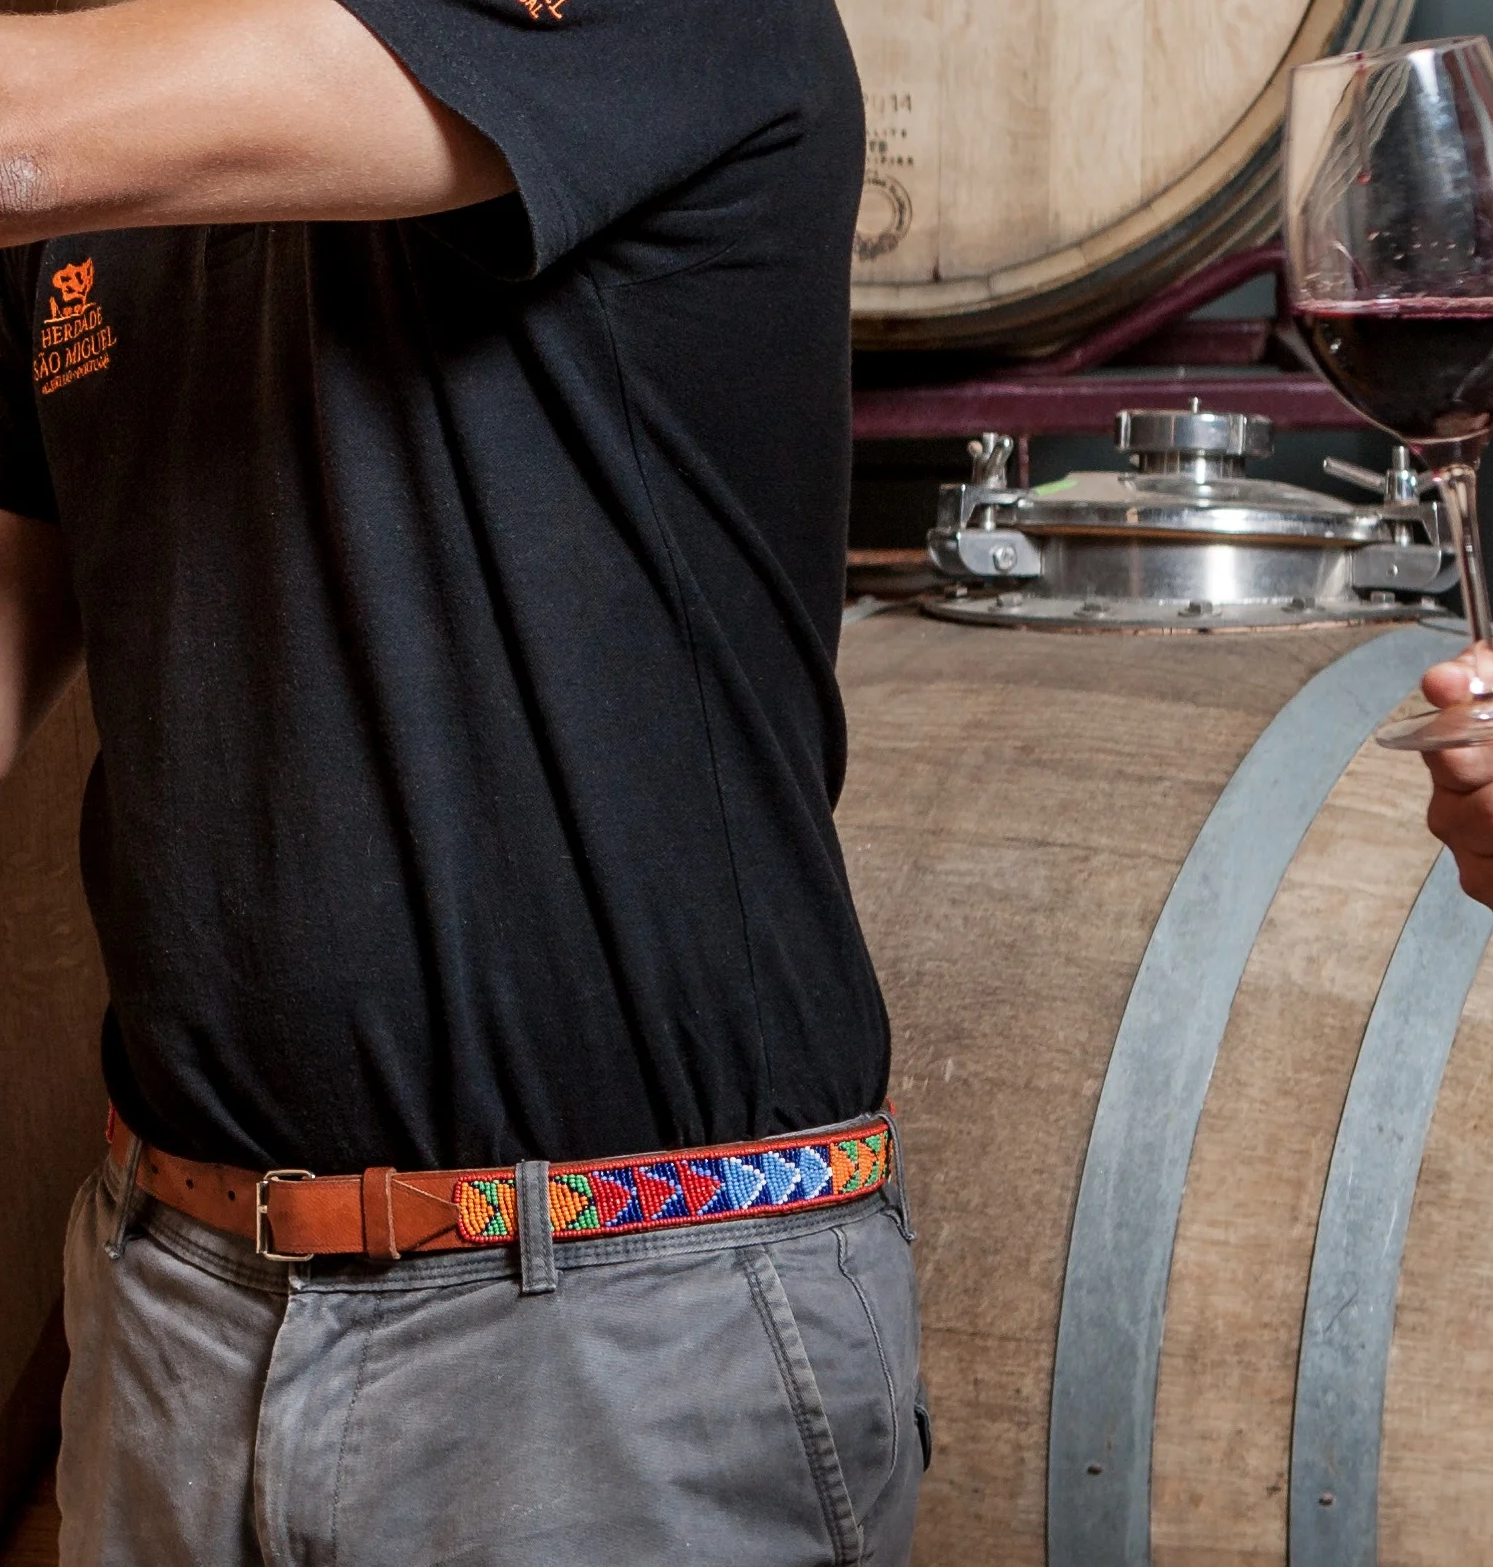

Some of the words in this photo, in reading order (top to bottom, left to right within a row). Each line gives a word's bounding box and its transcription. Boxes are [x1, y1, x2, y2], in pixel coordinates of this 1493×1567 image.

[41, 306, 103, 349] HERDADE
[33, 351, 61, 382] SÃO
[65, 325, 117, 368] MIGUEL
